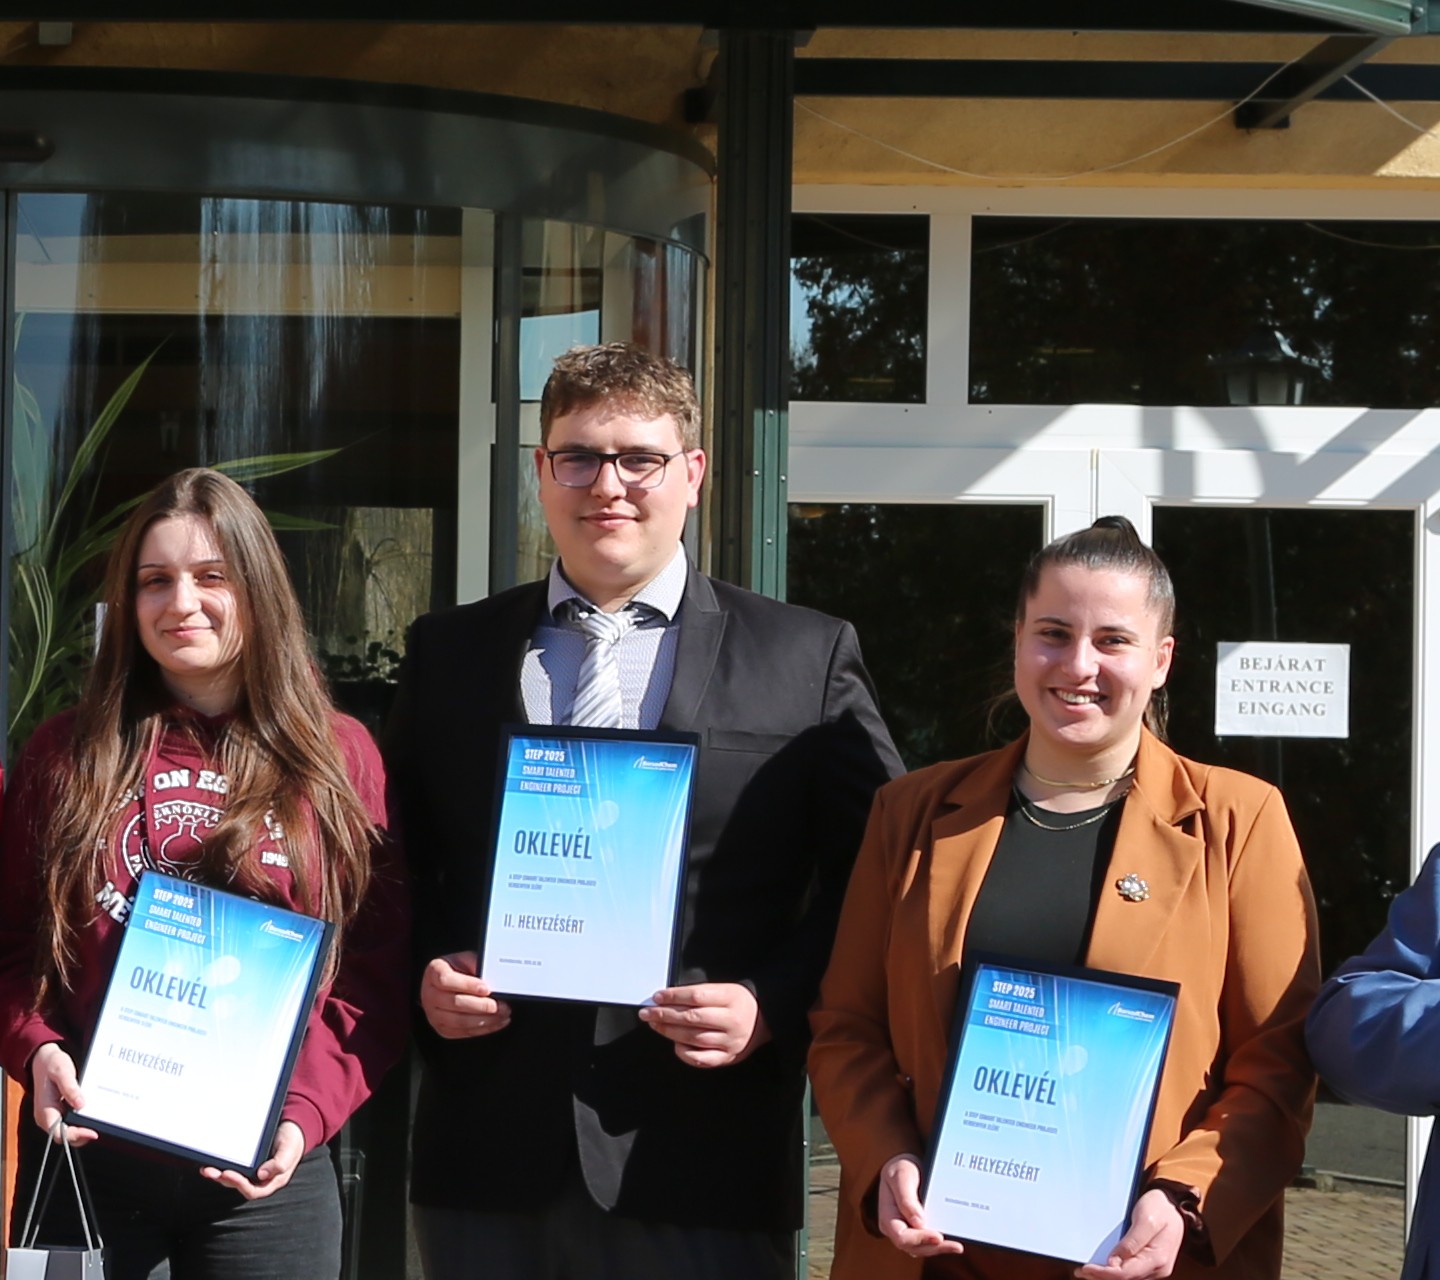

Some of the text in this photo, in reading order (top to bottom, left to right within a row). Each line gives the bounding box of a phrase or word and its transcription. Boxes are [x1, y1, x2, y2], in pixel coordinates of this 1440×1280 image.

[1240, 654, 1326, 671] BEJÁRAT
[1231, 679, 1334, 694] ENTRANCE
[1238, 702, 1326, 716] EINGANG
[524, 748, 565, 762] STEP 2025
[522, 765, 576, 778] SMART TALENTED
[520, 781, 582, 795] ENGINEER PROJECT
[514, 827, 592, 859] OKLEVÉL
[153, 888, 194, 908] STEP 2025
[149, 904, 202, 928] SMART TALENTED
[503, 912, 584, 934] II. HELYEZÉSÉRT
[144, 919, 207, 945] ENGINEER PROJECT
[130, 966, 208, 1009] OKLEVÉL
[992, 981, 1036, 999] STEP 2025
[988, 998, 1045, 1017] SMART TALENTED
[984, 1015, 1049, 1035] ENGINEER PROJECT
[118, 1046, 185, 1077] HELYEZÉSÉRT
[973, 1066, 1056, 1106] OKLEVÉL
[954, 1151, 1040, 1182] II. HELYEZÉSÉRT
